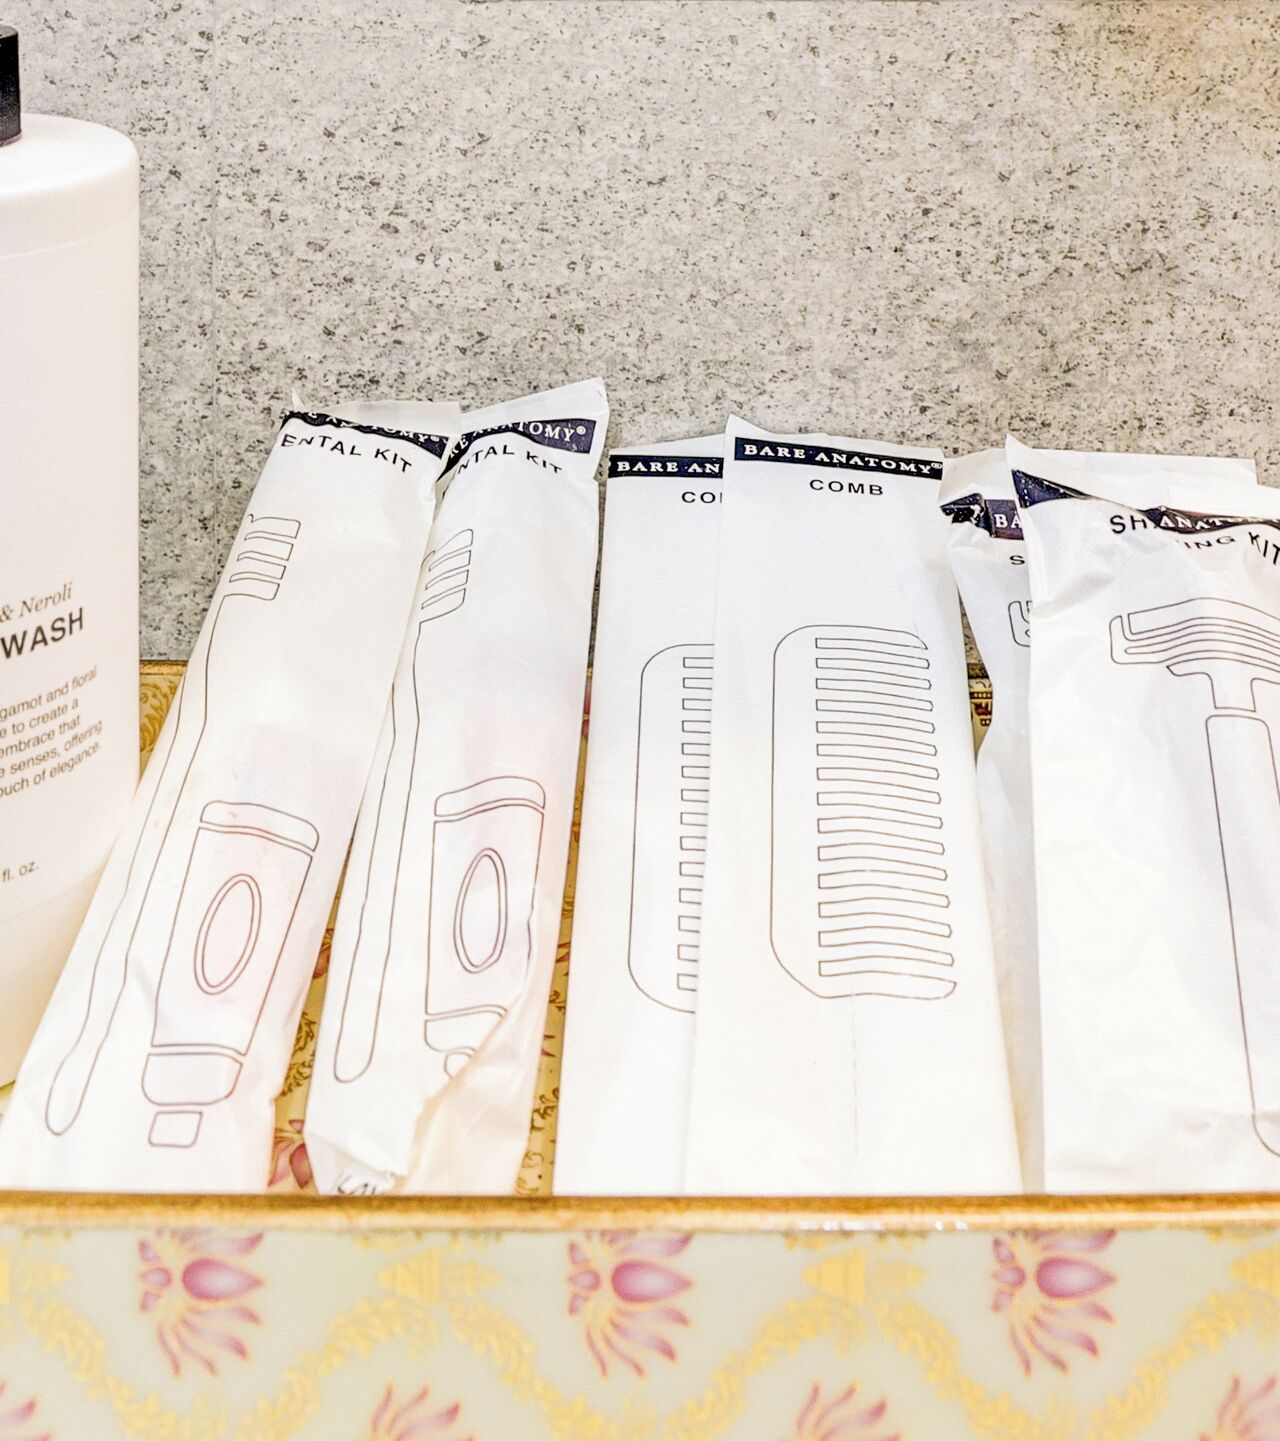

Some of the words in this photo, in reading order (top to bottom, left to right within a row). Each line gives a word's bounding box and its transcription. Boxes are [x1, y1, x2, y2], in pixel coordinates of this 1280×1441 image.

[280, 434, 362, 456] ENTAL
[374, 448, 412, 472] KIT
[526, 451, 563, 474] KIT
[743, 443, 806, 460] BARE
[617, 461, 679, 473] BARE
[809, 479, 884, 496] COMB
[0, 605, 14, 623] &
[19, 582, 73, 618] Neroli
[0, 608, 84, 659] WASH
[46, 683, 69, 703] and
[71, 666, 98, 689] floral
[12, 722, 25, 735] to
[28, 704, 68, 729] create
[71, 698, 80, 710] a
[58, 715, 81, 736] that
[10, 746, 61, 775] senses,
[64, 720, 104, 752] offering
[33, 769, 47, 785] of
[2, 868, 15, 886] fl.
[18, 860, 39, 878] oz.
